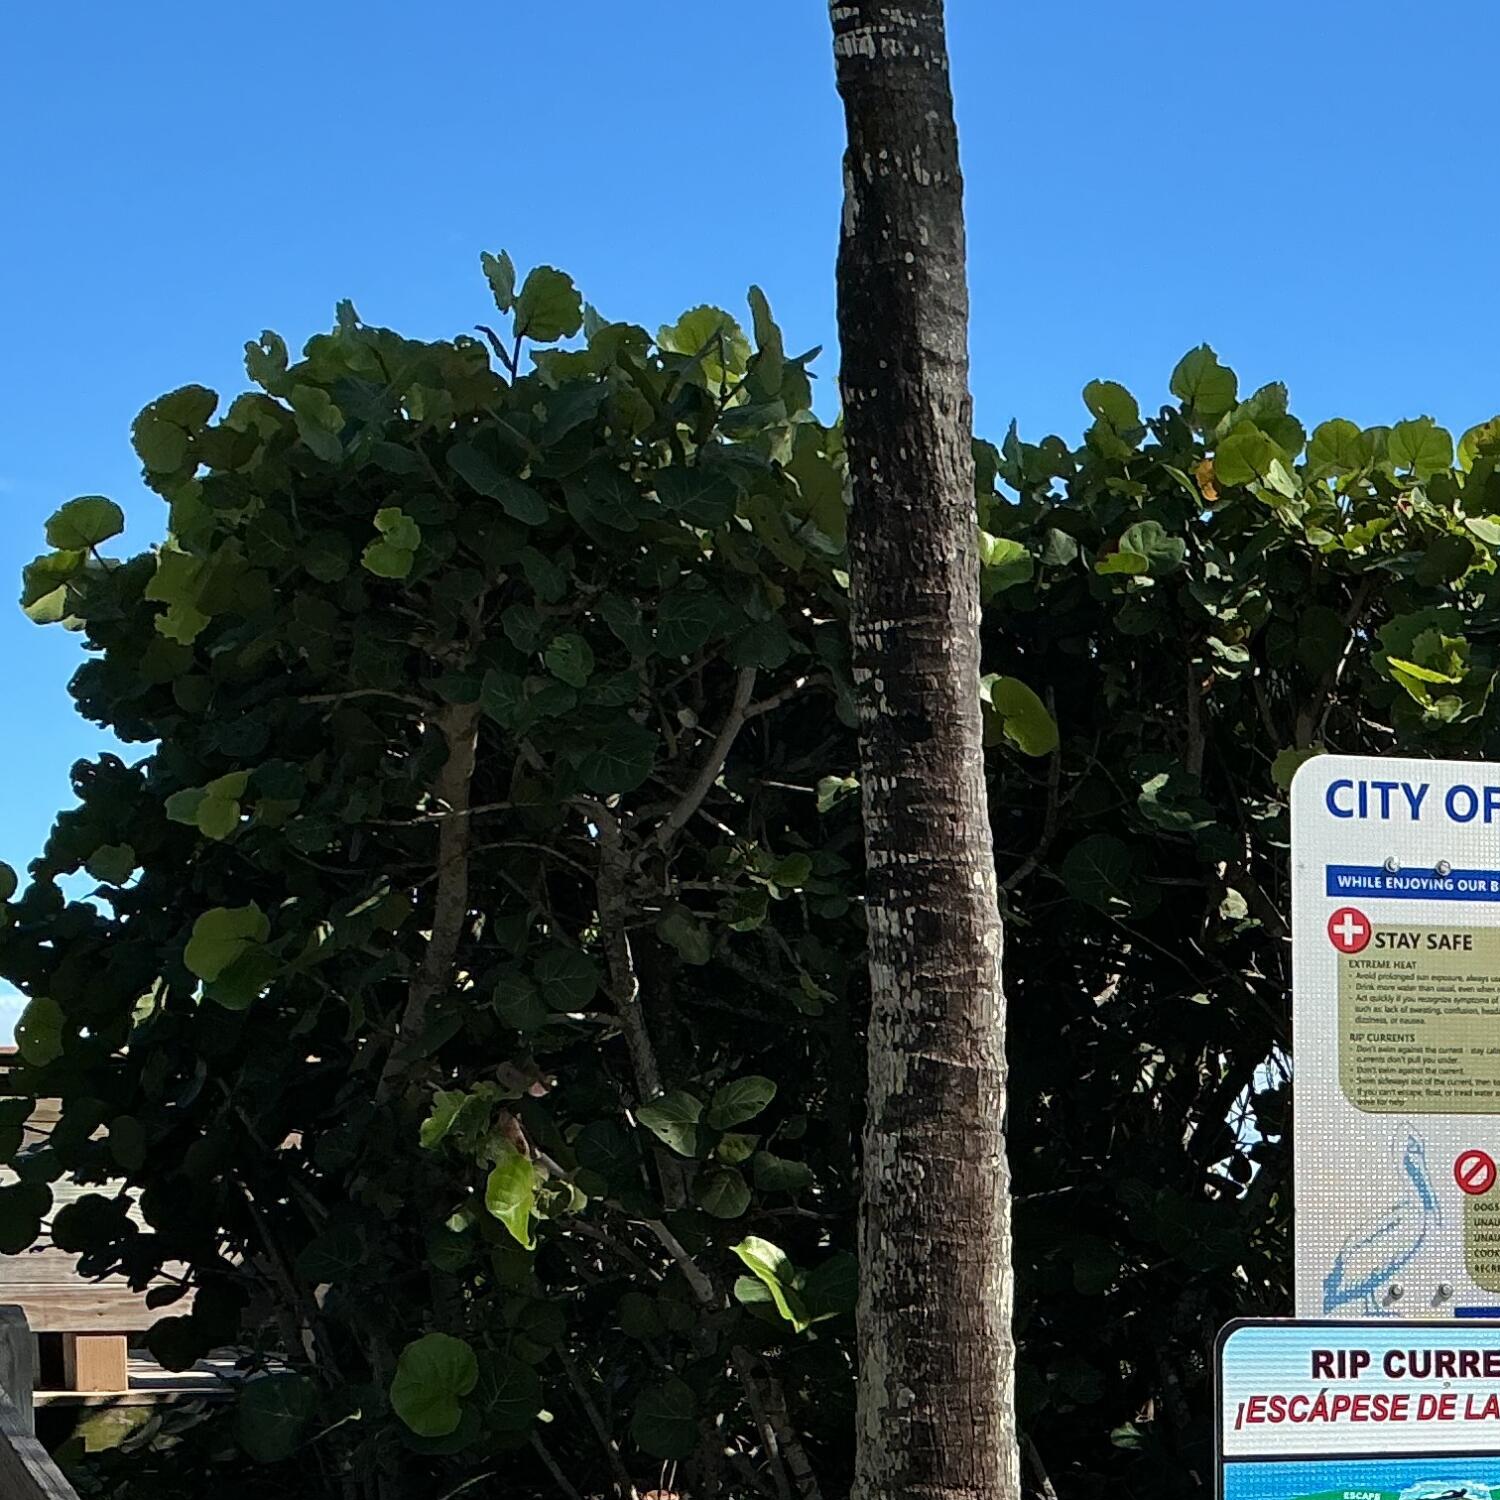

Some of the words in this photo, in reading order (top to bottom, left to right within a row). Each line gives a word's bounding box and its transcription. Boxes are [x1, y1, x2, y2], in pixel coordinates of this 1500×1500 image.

[1326, 779, 1429, 820] CITY
[1337, 876, 1381, 889] WHILE
[1386, 877, 1453, 891] ENJOYING
[1458, 879, 1486, 892] OUR
[1375, 932, 1421, 949] STAY
[1427, 934, 1472, 950] SAFE
[1349, 960, 1391, 969] EXTREME
[1394, 961, 1416, 969] HEAT
[1350, 1034, 1365, 1042] RIP
[1367, 1034, 1415, 1042] CURRENTS
[1311, 1350, 1370, 1379] RIP
[1234, 1388, 1410, 1430] ¡ESCÁPESE
[1417, 1395, 1457, 1420] DE
[1464, 1394, 1500, 1419] LA
[1344, 1492, 1381, 1500] ESCAPE
